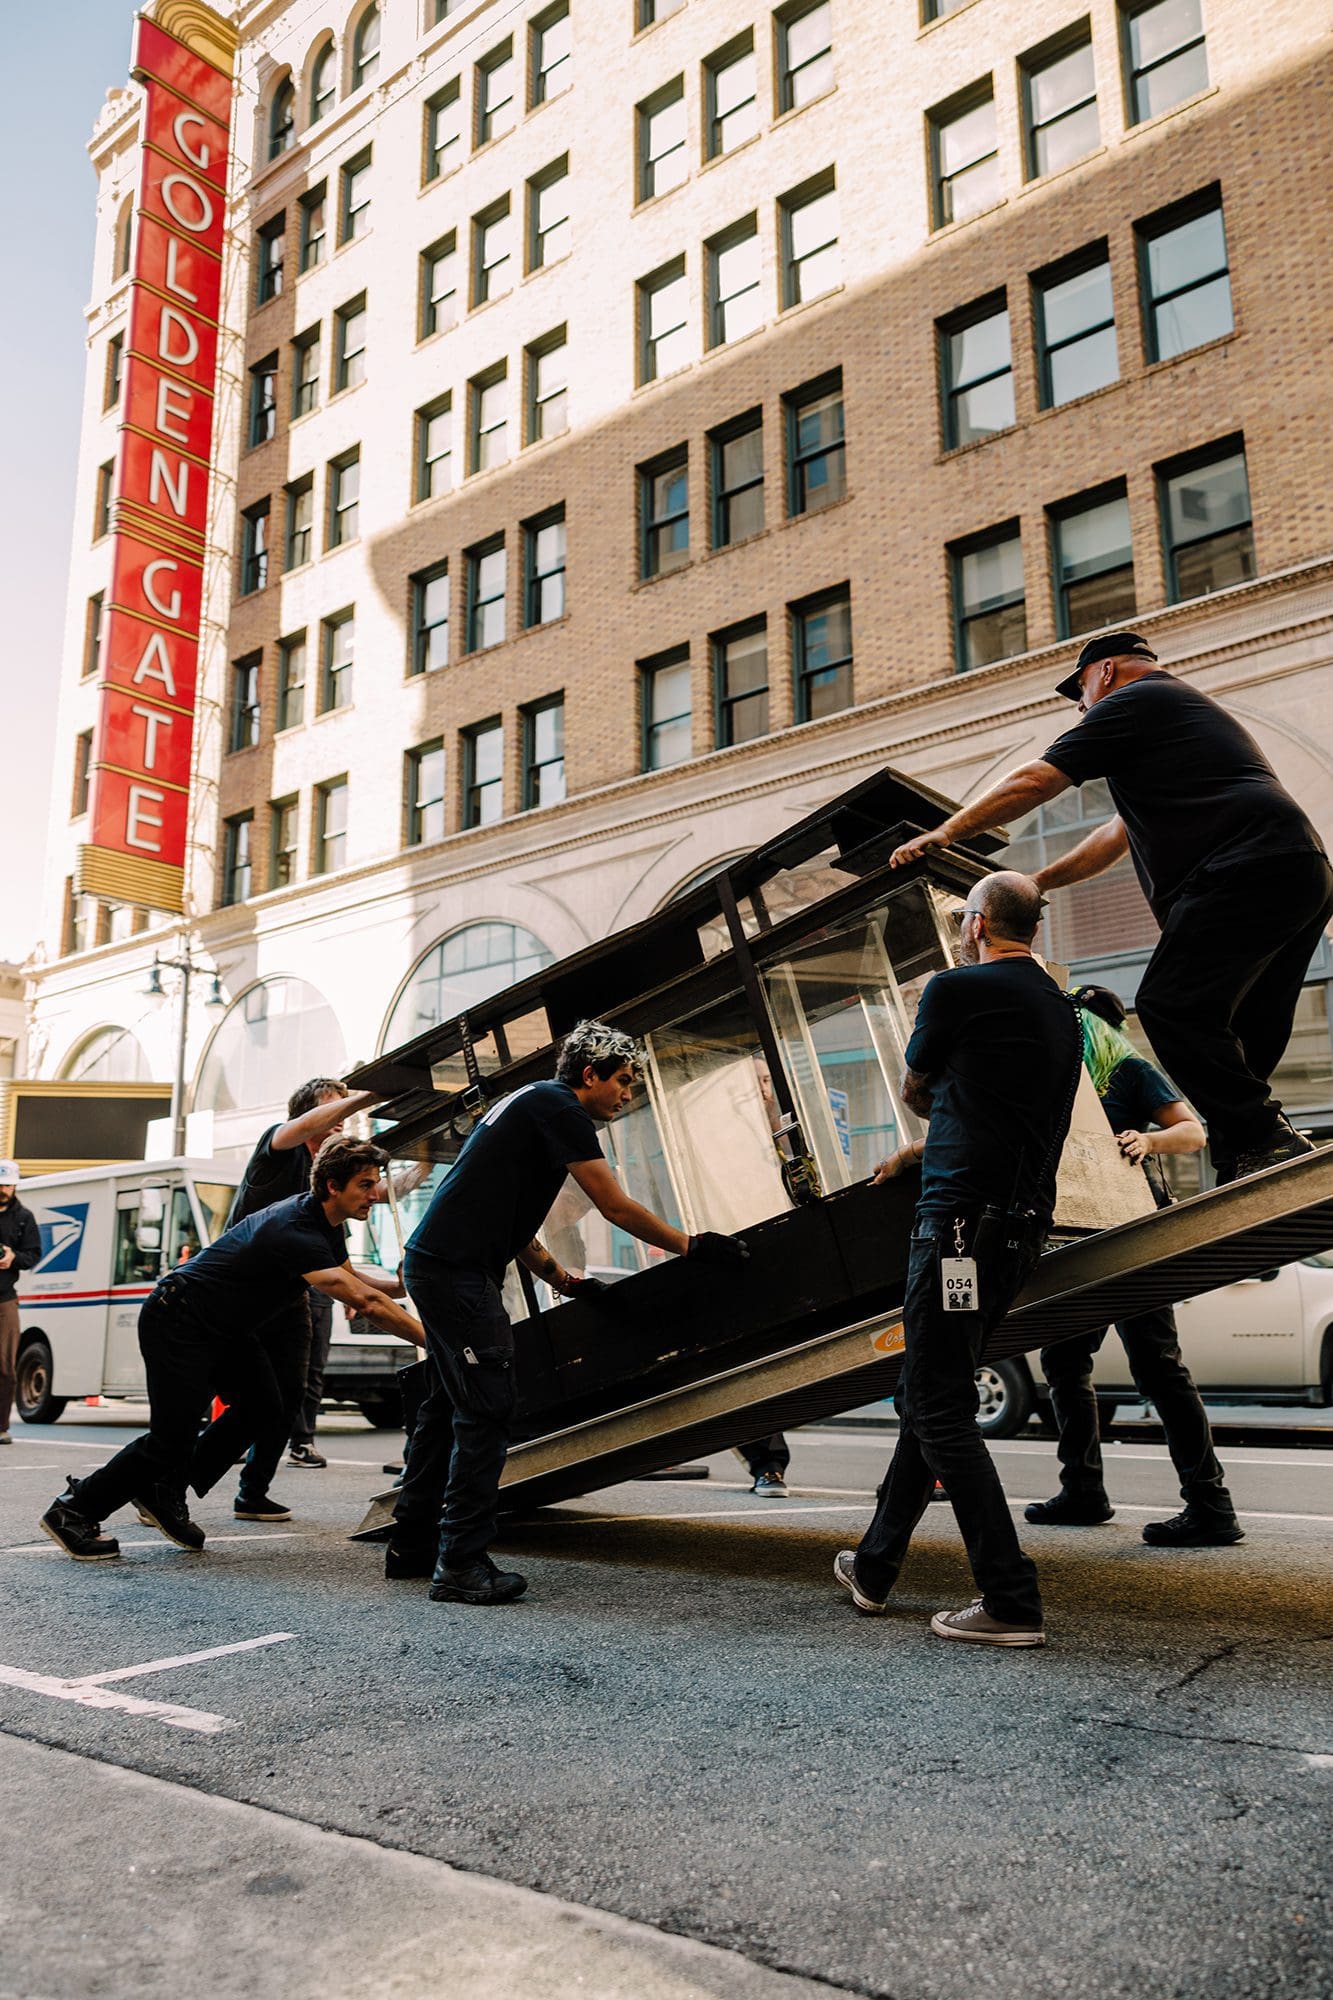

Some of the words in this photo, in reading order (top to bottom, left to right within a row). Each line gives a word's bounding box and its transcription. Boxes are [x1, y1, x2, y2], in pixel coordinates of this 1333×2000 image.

[148, 111, 214, 518] GOLDEN
[126, 558, 181, 853] GATE
[946, 1278, 973, 1290] 054
